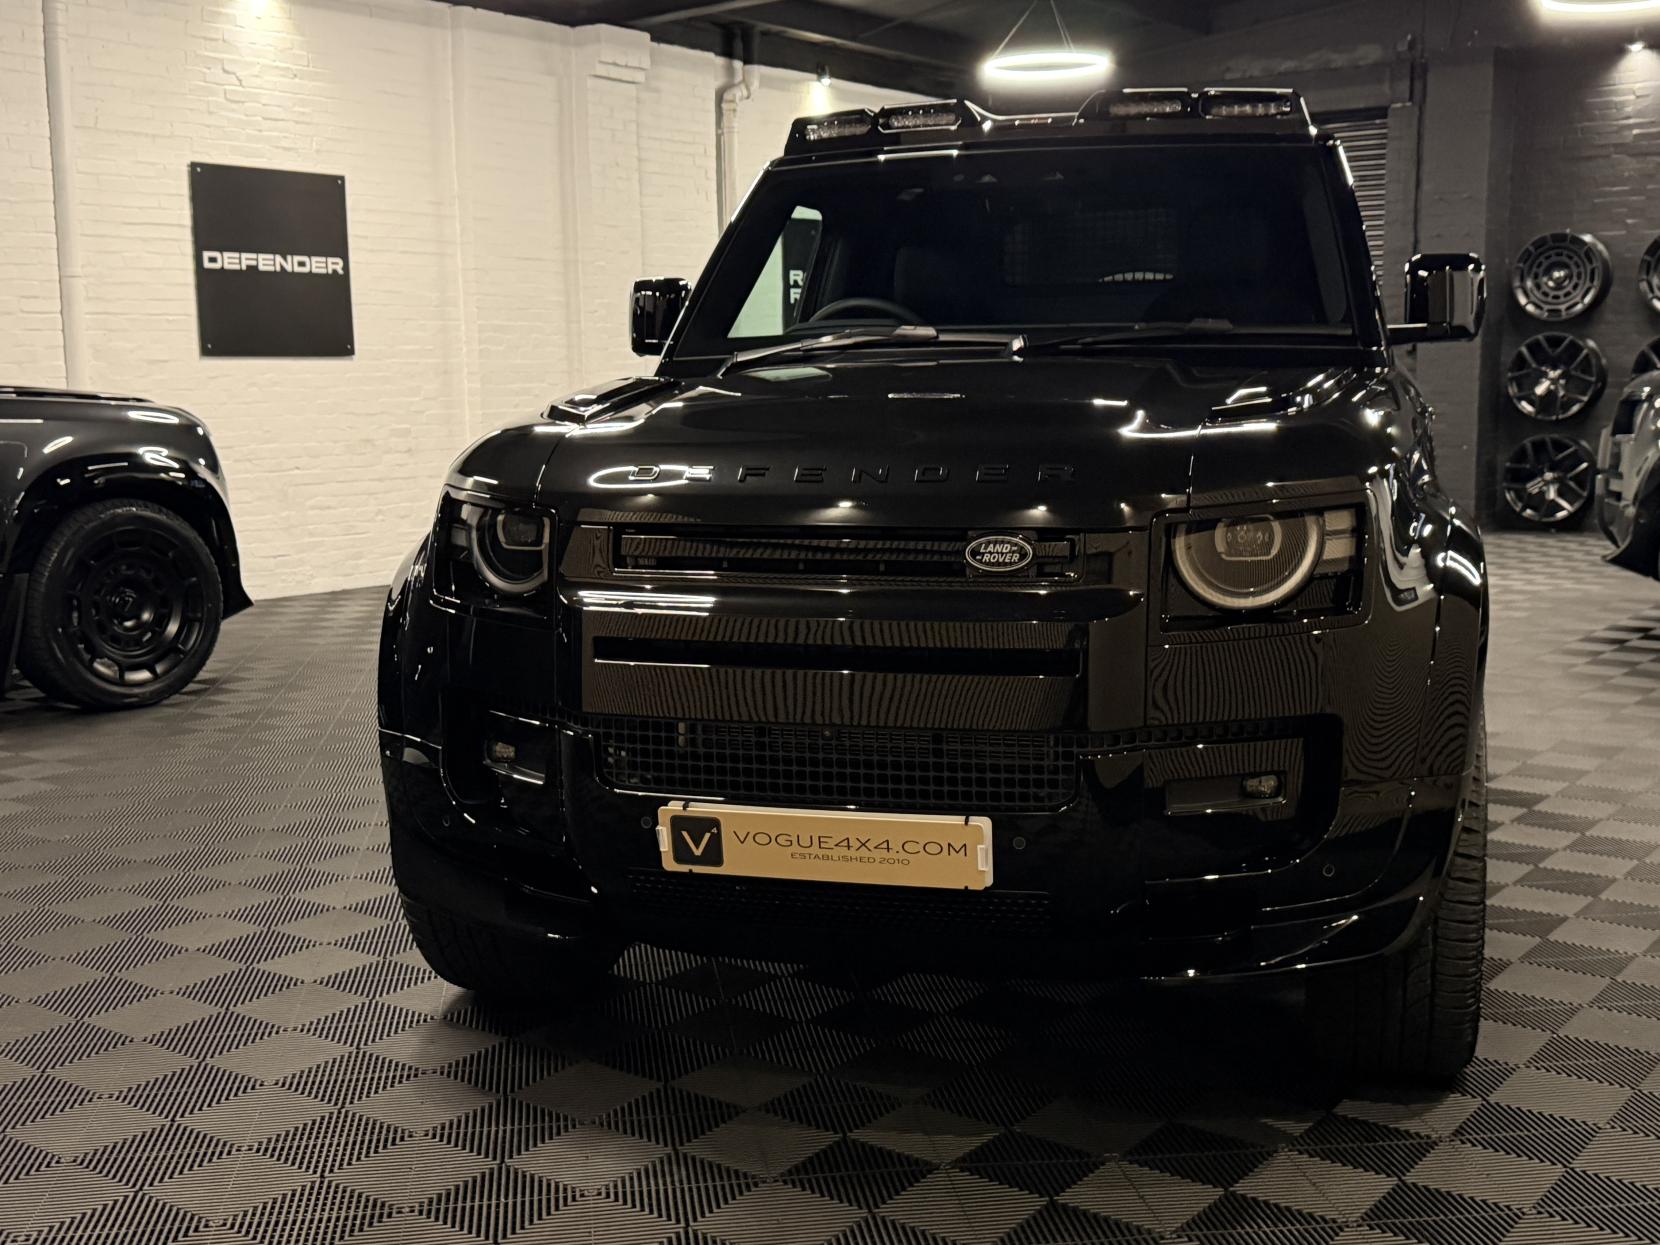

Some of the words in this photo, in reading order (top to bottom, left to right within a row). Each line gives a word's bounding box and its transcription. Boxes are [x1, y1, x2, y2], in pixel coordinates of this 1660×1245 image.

[202, 250, 345, 275] DEFENDER
[627, 463, 1078, 485] DEFENDER
[733, 829, 969, 858] VOGUE4X4.COM
[790, 851, 876, 864] ESTABLISHED
[878, 857, 910, 866] 2010
